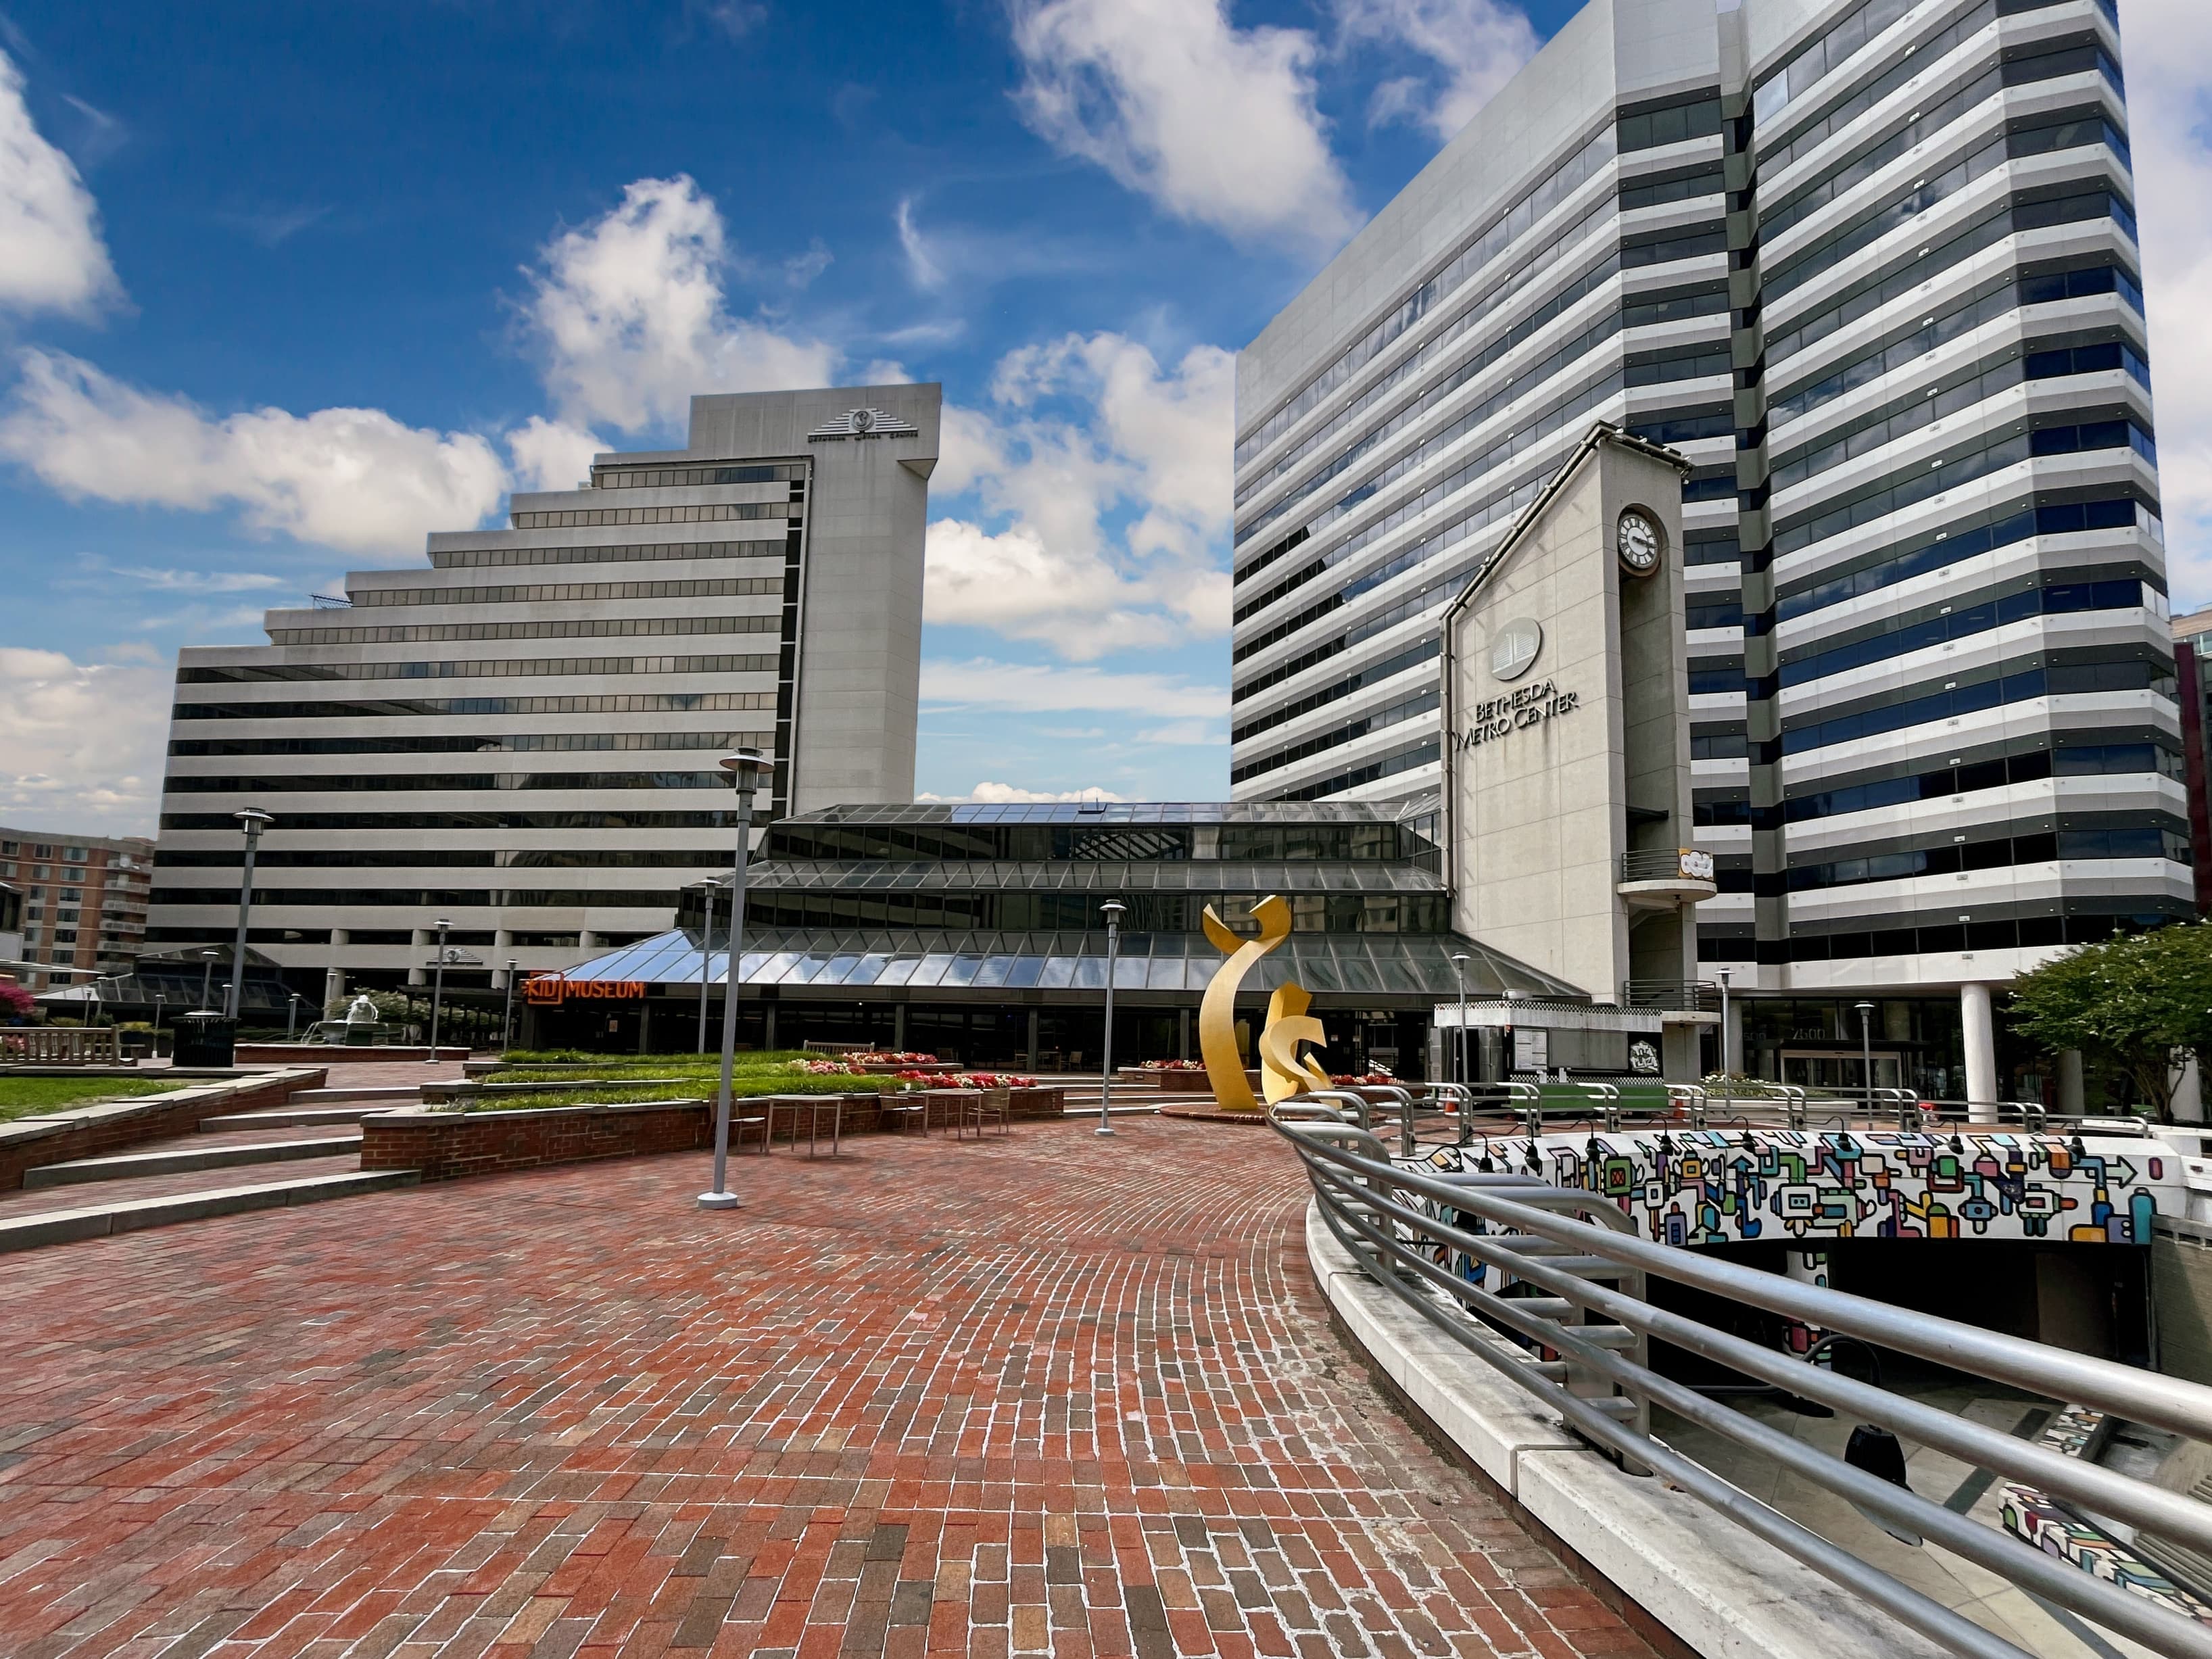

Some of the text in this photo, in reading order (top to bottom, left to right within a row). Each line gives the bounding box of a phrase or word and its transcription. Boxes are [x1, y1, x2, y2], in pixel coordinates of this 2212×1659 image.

[1456, 692, 1579, 751] METRO CENTER
[1476, 678, 1557, 723] BETHESDA
[565, 980, 645, 999] MUSEUM
